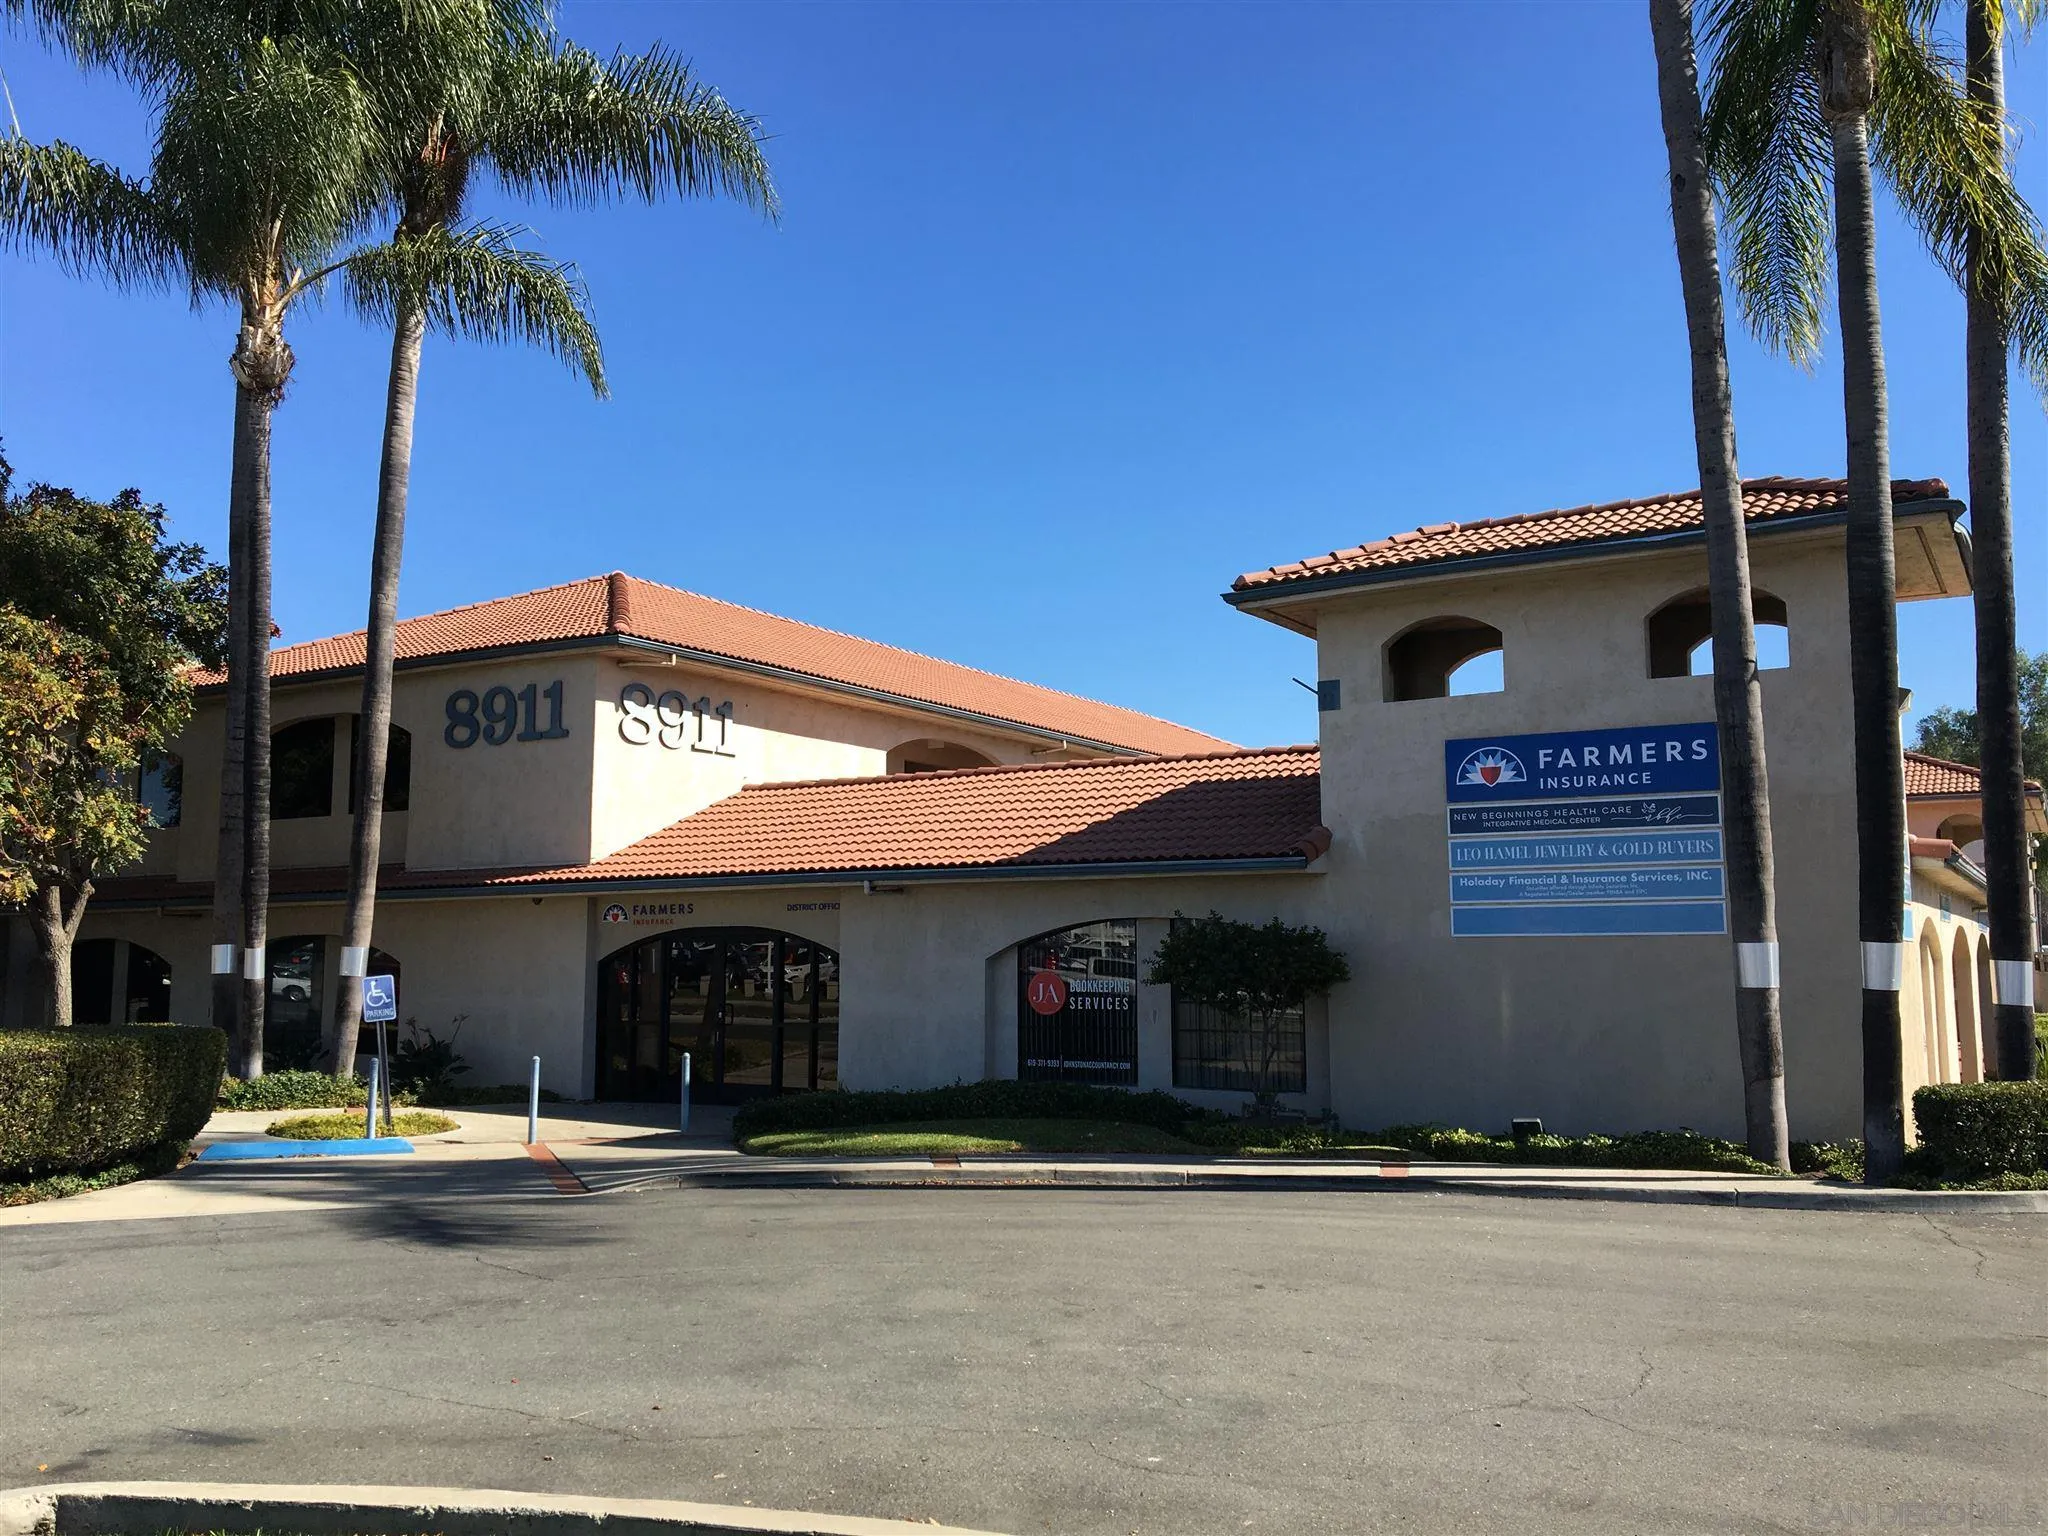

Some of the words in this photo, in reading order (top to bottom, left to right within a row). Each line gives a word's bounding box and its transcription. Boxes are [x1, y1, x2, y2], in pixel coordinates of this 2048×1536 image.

[444, 680, 569, 749] 8911
[618, 682, 736, 758] 8911
[1538, 739, 1708, 769] FARMERS
[1540, 772, 1652, 790] INSURANCE
[1453, 813, 1477, 821] NEW
[1481, 810, 1549, 820] BEGINNINGS
[1554, 808, 1597, 817] HEALTH
[1601, 806, 1632, 815] CARE
[1483, 820, 1531, 828] INTEGRATIVE
[1533, 818, 1568, 826] MEDICAL
[1569, 816, 1601, 825] CENTER
[1456, 848, 1482, 861] LEO
[1485, 846, 1531, 860] HAMEL
[1535, 843, 1595, 859] JEWELRY
[1598, 844, 1609, 857] &
[1612, 841, 1654, 856] GOLD
[1658, 839, 1715, 855] BUYERS
[1460, 876, 1506, 888] Holaday
[1509, 875, 1557, 886] Financial
[1560, 874, 1570, 885] &
[1573, 874, 1628, 884] Insurance
[1631, 871, 1683, 883] Services,
[1687, 870, 1713, 881] INC.
[632, 904, 694, 915] FARMERS
[787, 903, 817, 911] DISTRICT
[819, 902, 840, 911] OFFIC
[1032, 983, 1059, 1003] JA
[1070, 979, 1130, 993] BOOKKEEPING
[1069, 996, 1129, 1010] SERVICES
[366, 1008, 394, 1018] PARKING
